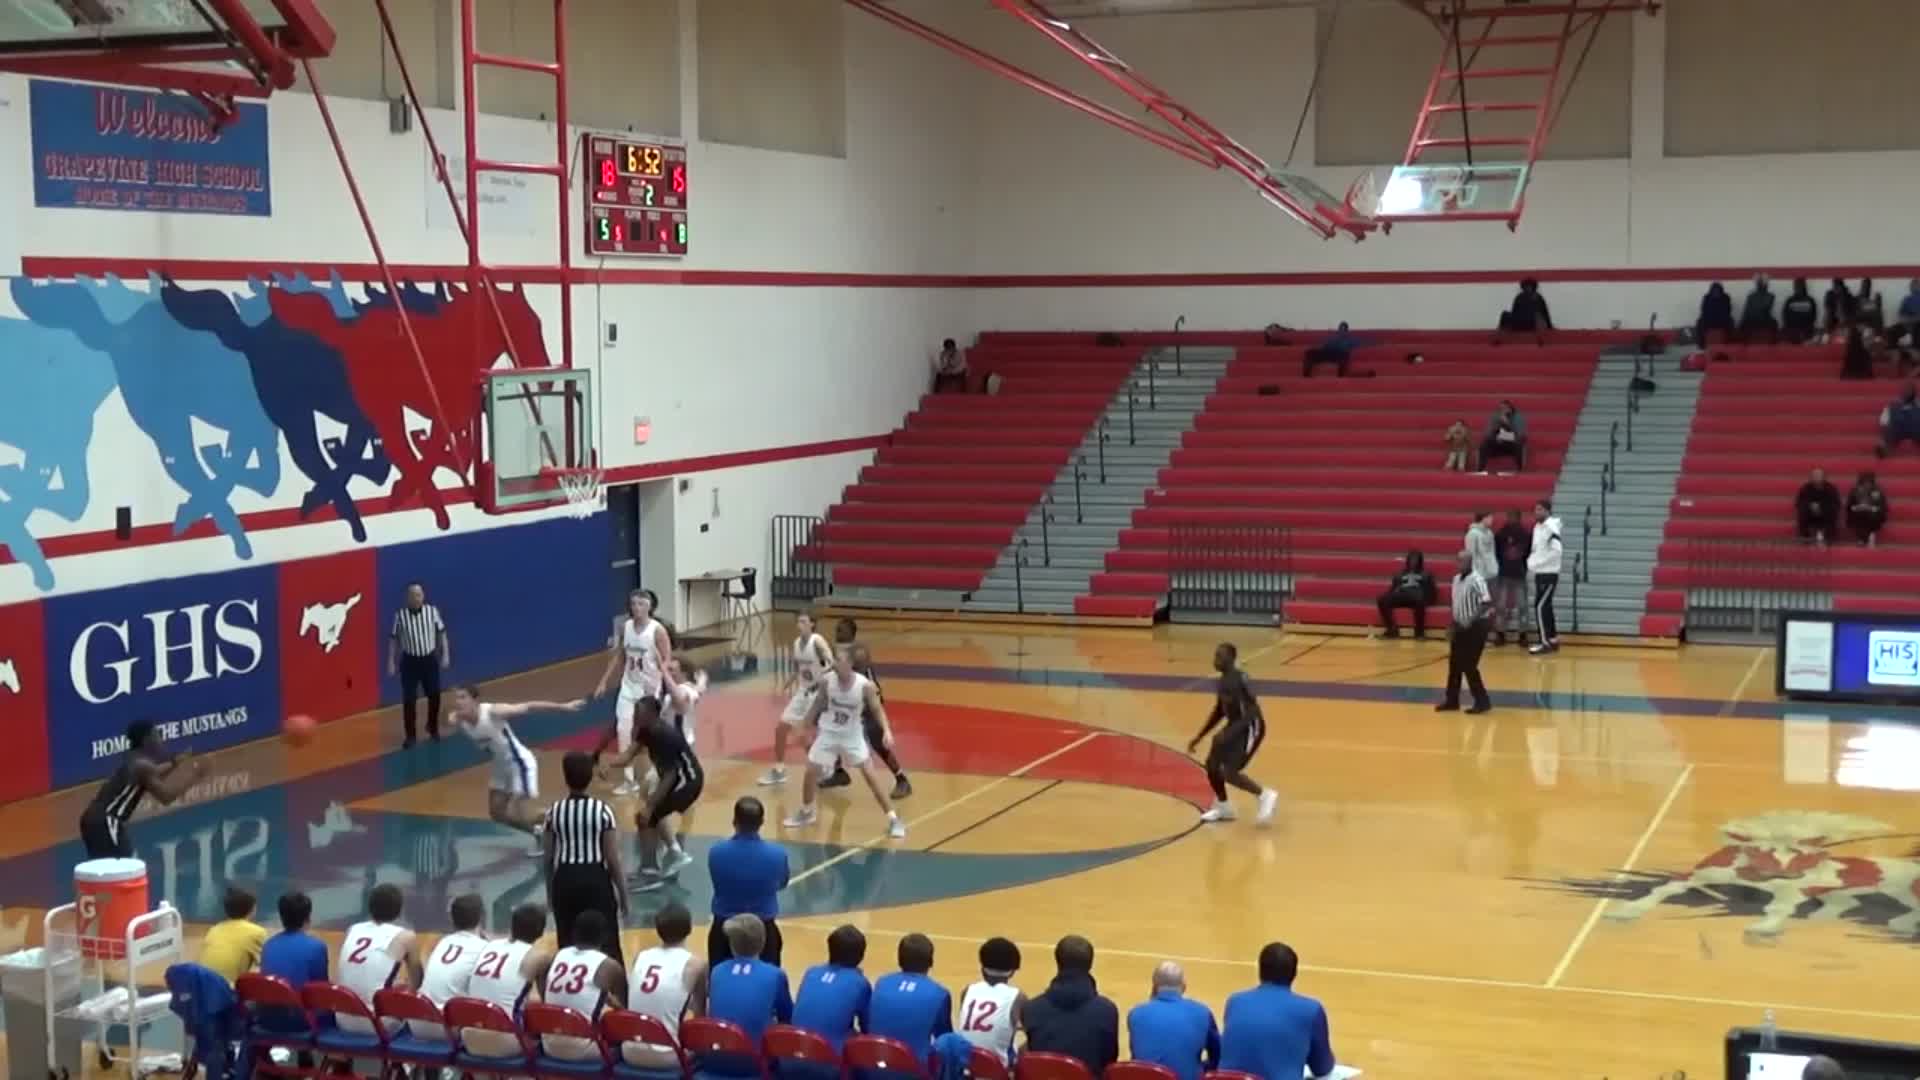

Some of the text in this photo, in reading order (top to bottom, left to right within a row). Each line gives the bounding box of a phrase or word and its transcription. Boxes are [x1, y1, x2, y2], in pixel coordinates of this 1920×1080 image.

[44, 154, 264, 192] GRAPEVINE HIGH SCHOOL
[602, 159, 615, 187] 18
[628, 145, 661, 175] 6:52
[673, 165, 685, 193] 15
[645, 183, 654, 206] 2
[601, 218, 609, 240] 5
[70, 599, 262, 704] GHS
[1880, 643, 1914, 659] HIS
[91, 706, 248, 760] HOM THE MUSTANGS
[80, 895, 97, 919] G
[349, 936, 372, 965] 2
[475, 951, 508, 980] 21
[548, 961, 589, 995] 23
[640, 964, 663, 994] 5
[963, 1000, 998, 1032] 12
